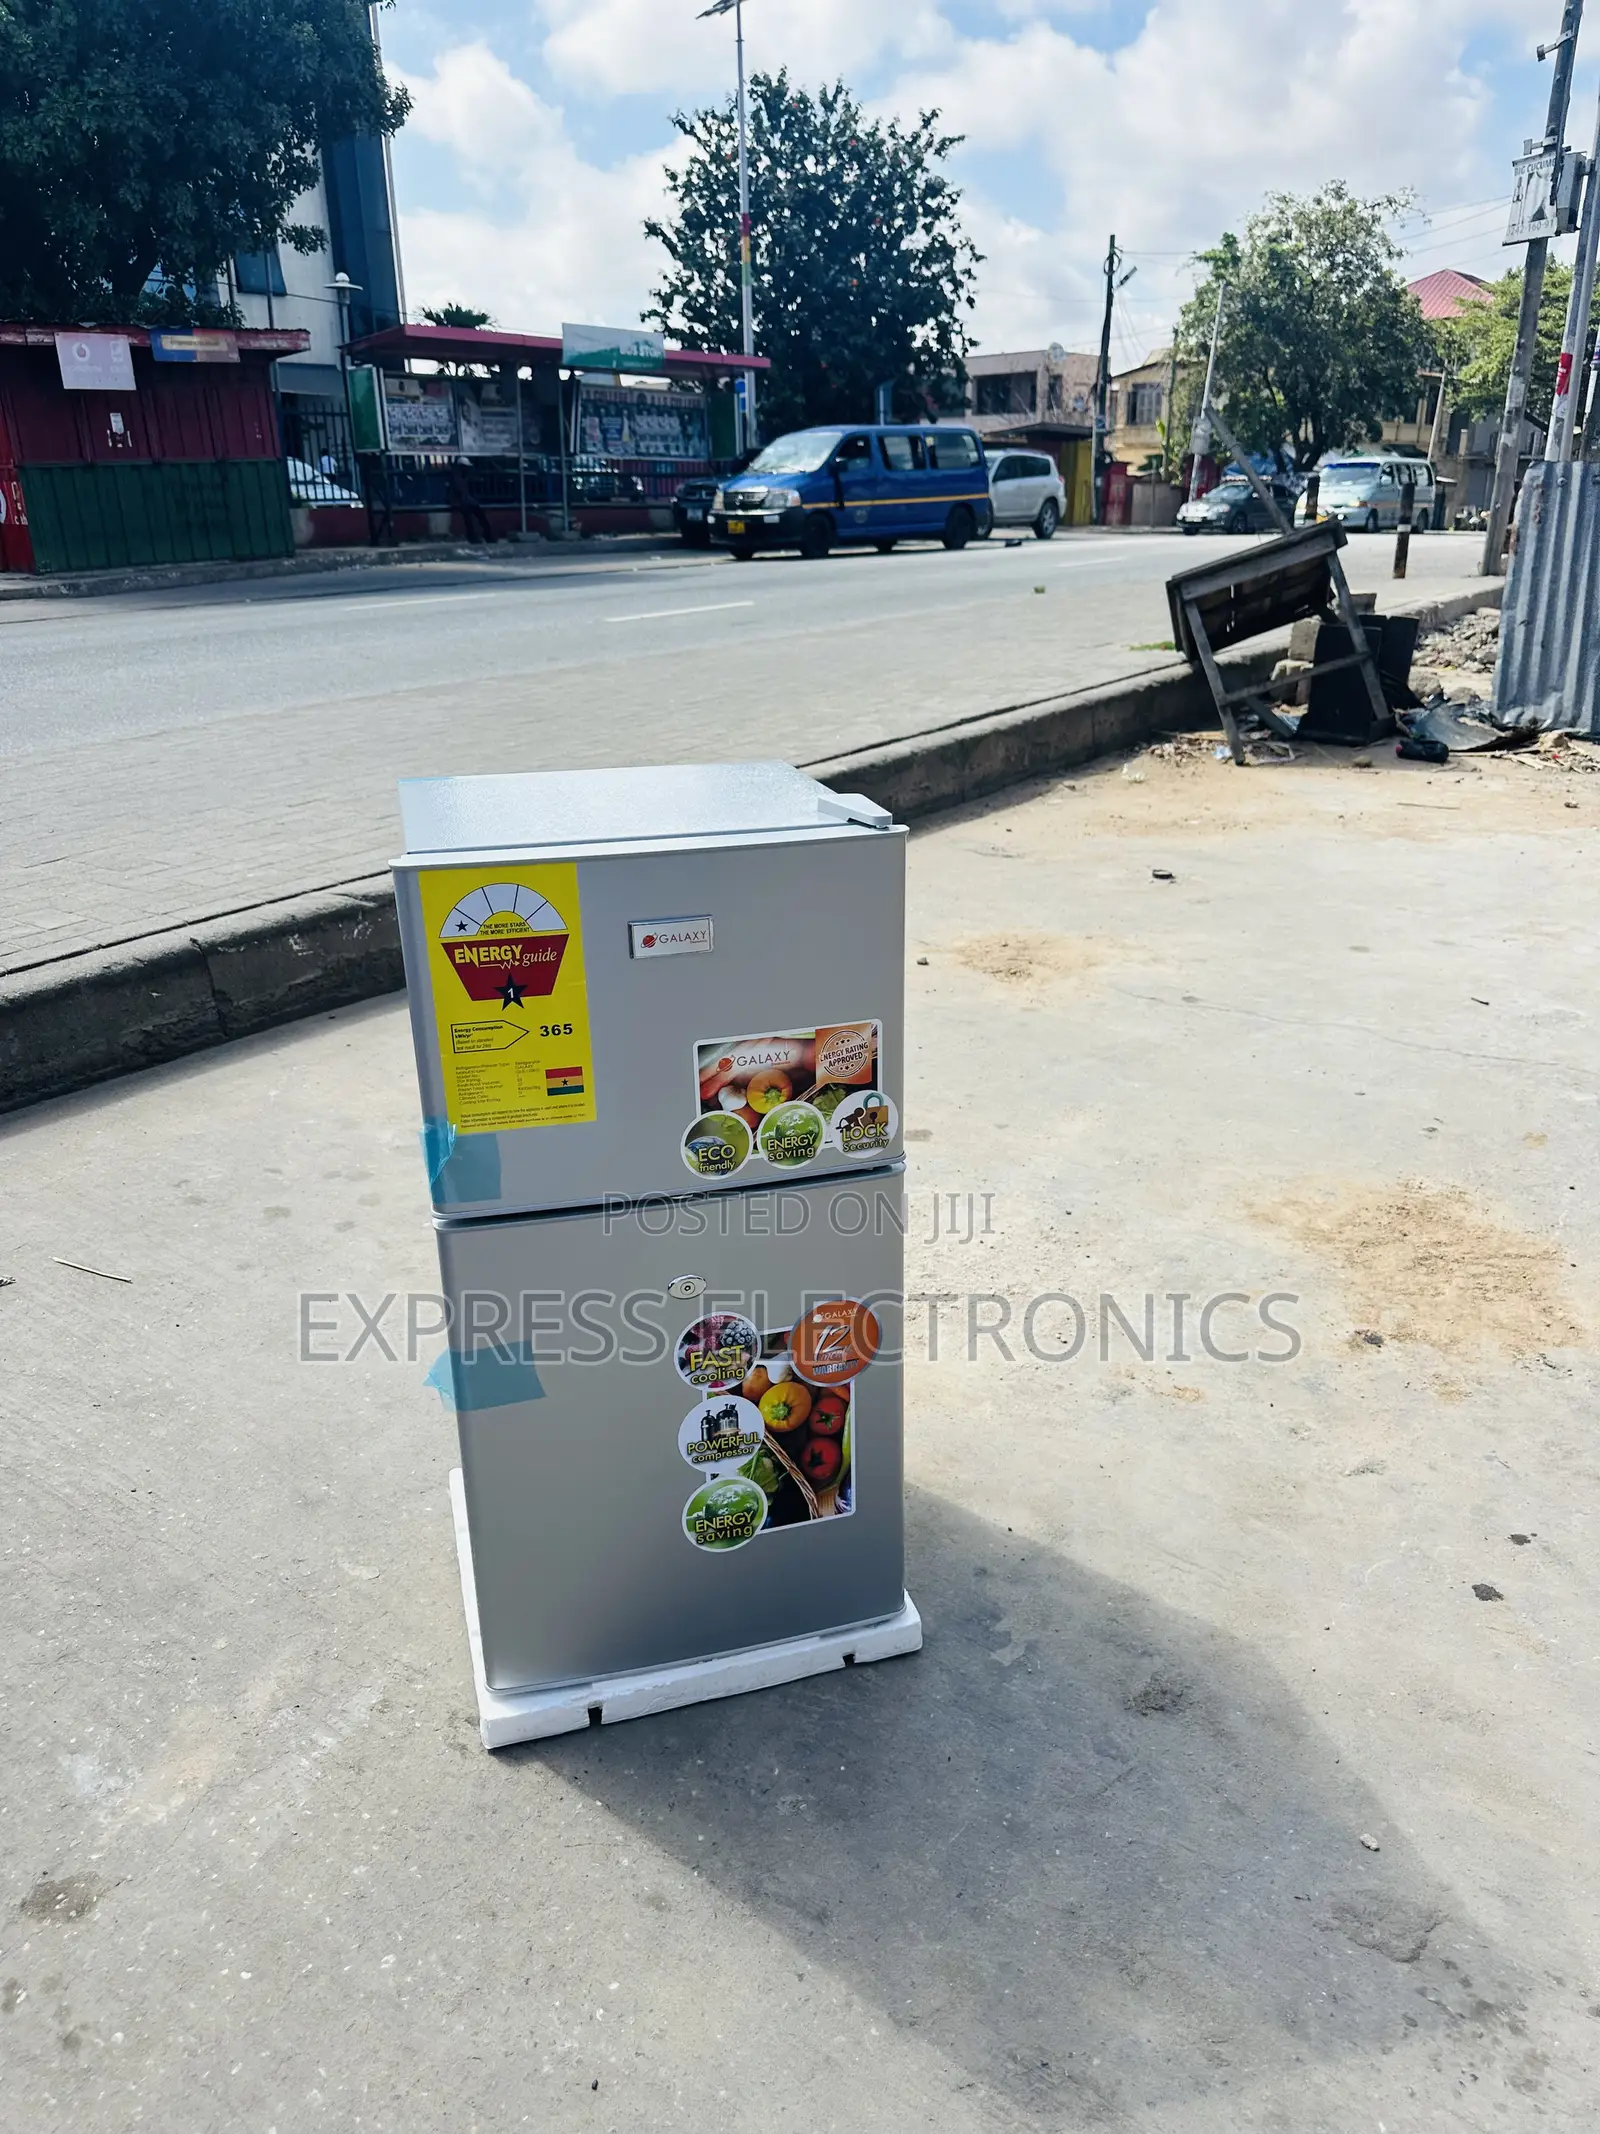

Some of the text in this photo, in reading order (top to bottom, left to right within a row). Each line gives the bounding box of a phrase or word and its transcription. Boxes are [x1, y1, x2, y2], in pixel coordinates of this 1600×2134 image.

[658, 930, 707, 944] GALAXY
[454, 943, 558, 968] ENERGY guide
[507, 988, 514, 998] 1
[540, 1023, 573, 1037] 365
[845, 1042, 869, 1054] RATING
[736, 1050, 791, 1067] GALAXY
[828, 1052, 863, 1068] APPROVED
[842, 1122, 887, 1142] LOCK
[767, 1133, 816, 1151] ENERGY
[842, 1138, 889, 1152] Security
[698, 1144, 736, 1162] ECO
[768, 1147, 815, 1161] saving
[699, 1160, 736, 1173] friendly
[824, 1307, 858, 1319] GALAXY
[814, 1324, 851, 1362] 12
[689, 1344, 746, 1372] FAST
[690, 1367, 745, 1384] cooling
[687, 1431, 761, 1455] POWERFUL
[692, 1446, 755, 1463] compressor
[695, 1510, 754, 1533] ENERGY
[697, 1525, 753, 1544] saving
